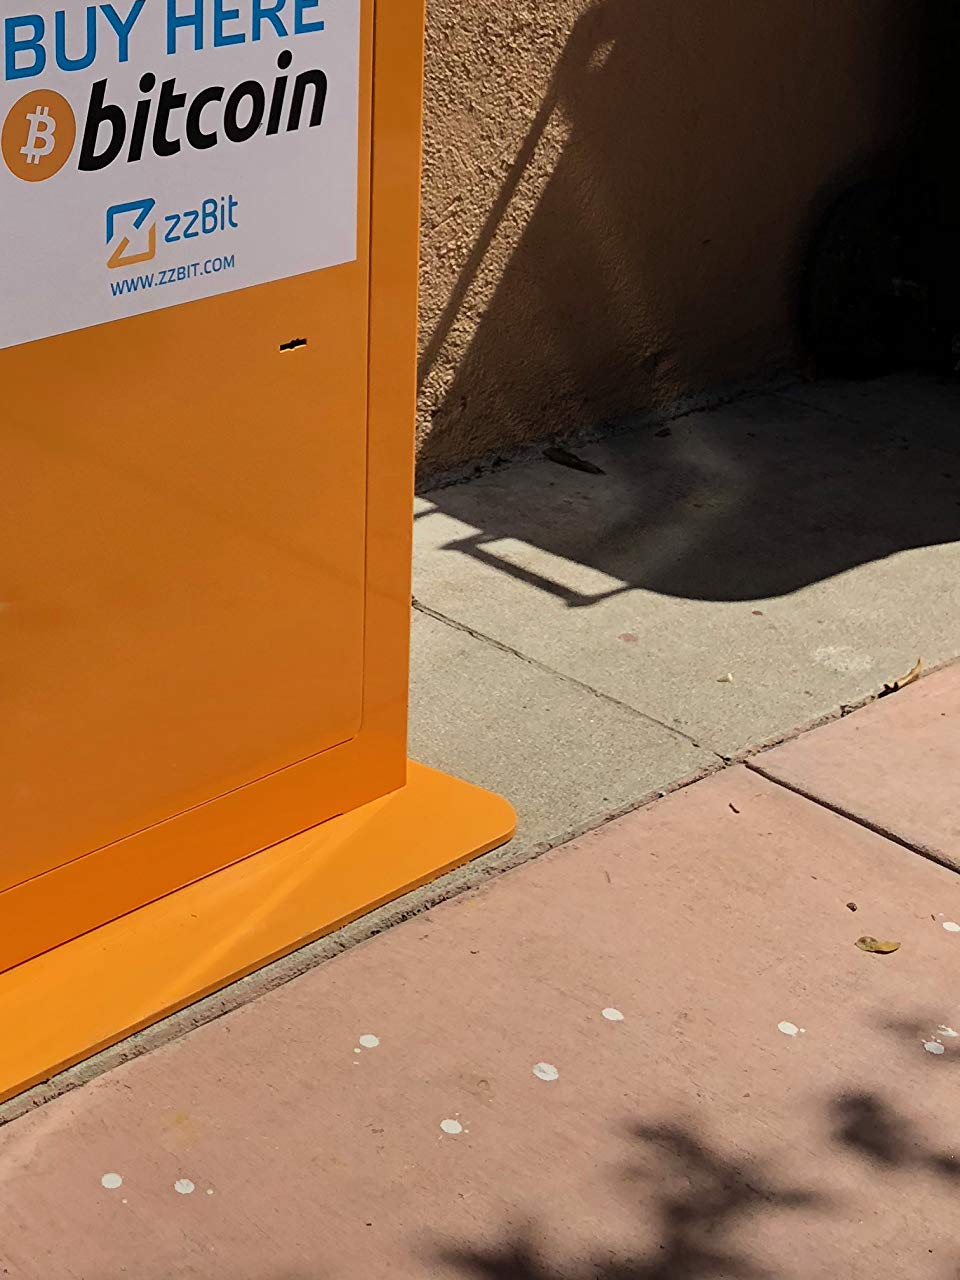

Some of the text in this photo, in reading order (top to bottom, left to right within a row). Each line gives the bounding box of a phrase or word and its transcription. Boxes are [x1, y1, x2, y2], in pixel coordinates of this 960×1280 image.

[77, 49, 328, 172] bitcoin
[164, 194, 238, 243] zzBit
[110, 254, 235, 297] WWW.ZZBIT.COM
